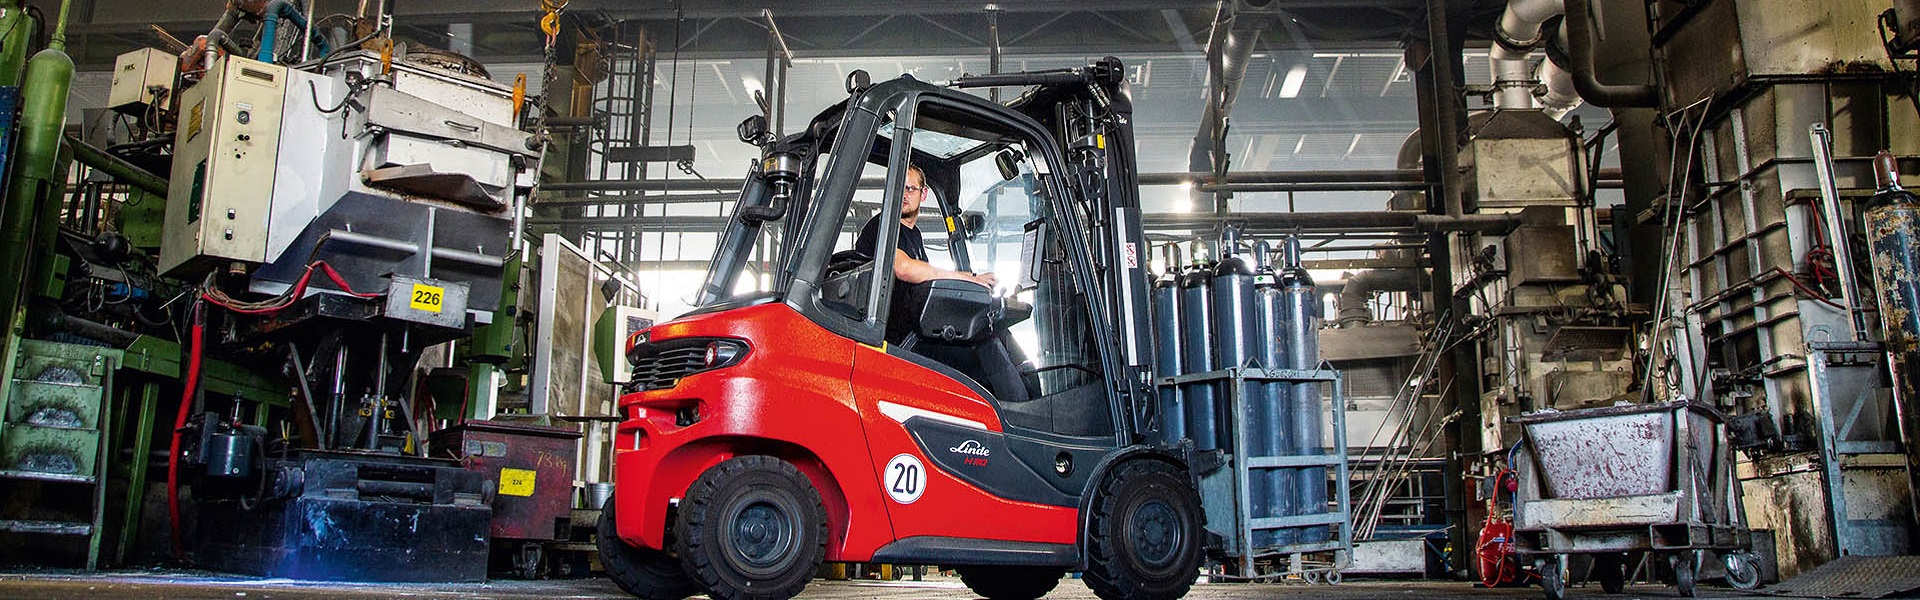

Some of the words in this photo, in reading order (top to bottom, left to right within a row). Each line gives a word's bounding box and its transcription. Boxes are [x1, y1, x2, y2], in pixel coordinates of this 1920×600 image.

[414, 290, 440, 306] 226
[950, 440, 990, 456] Linde
[893, 462, 918, 495] 20
